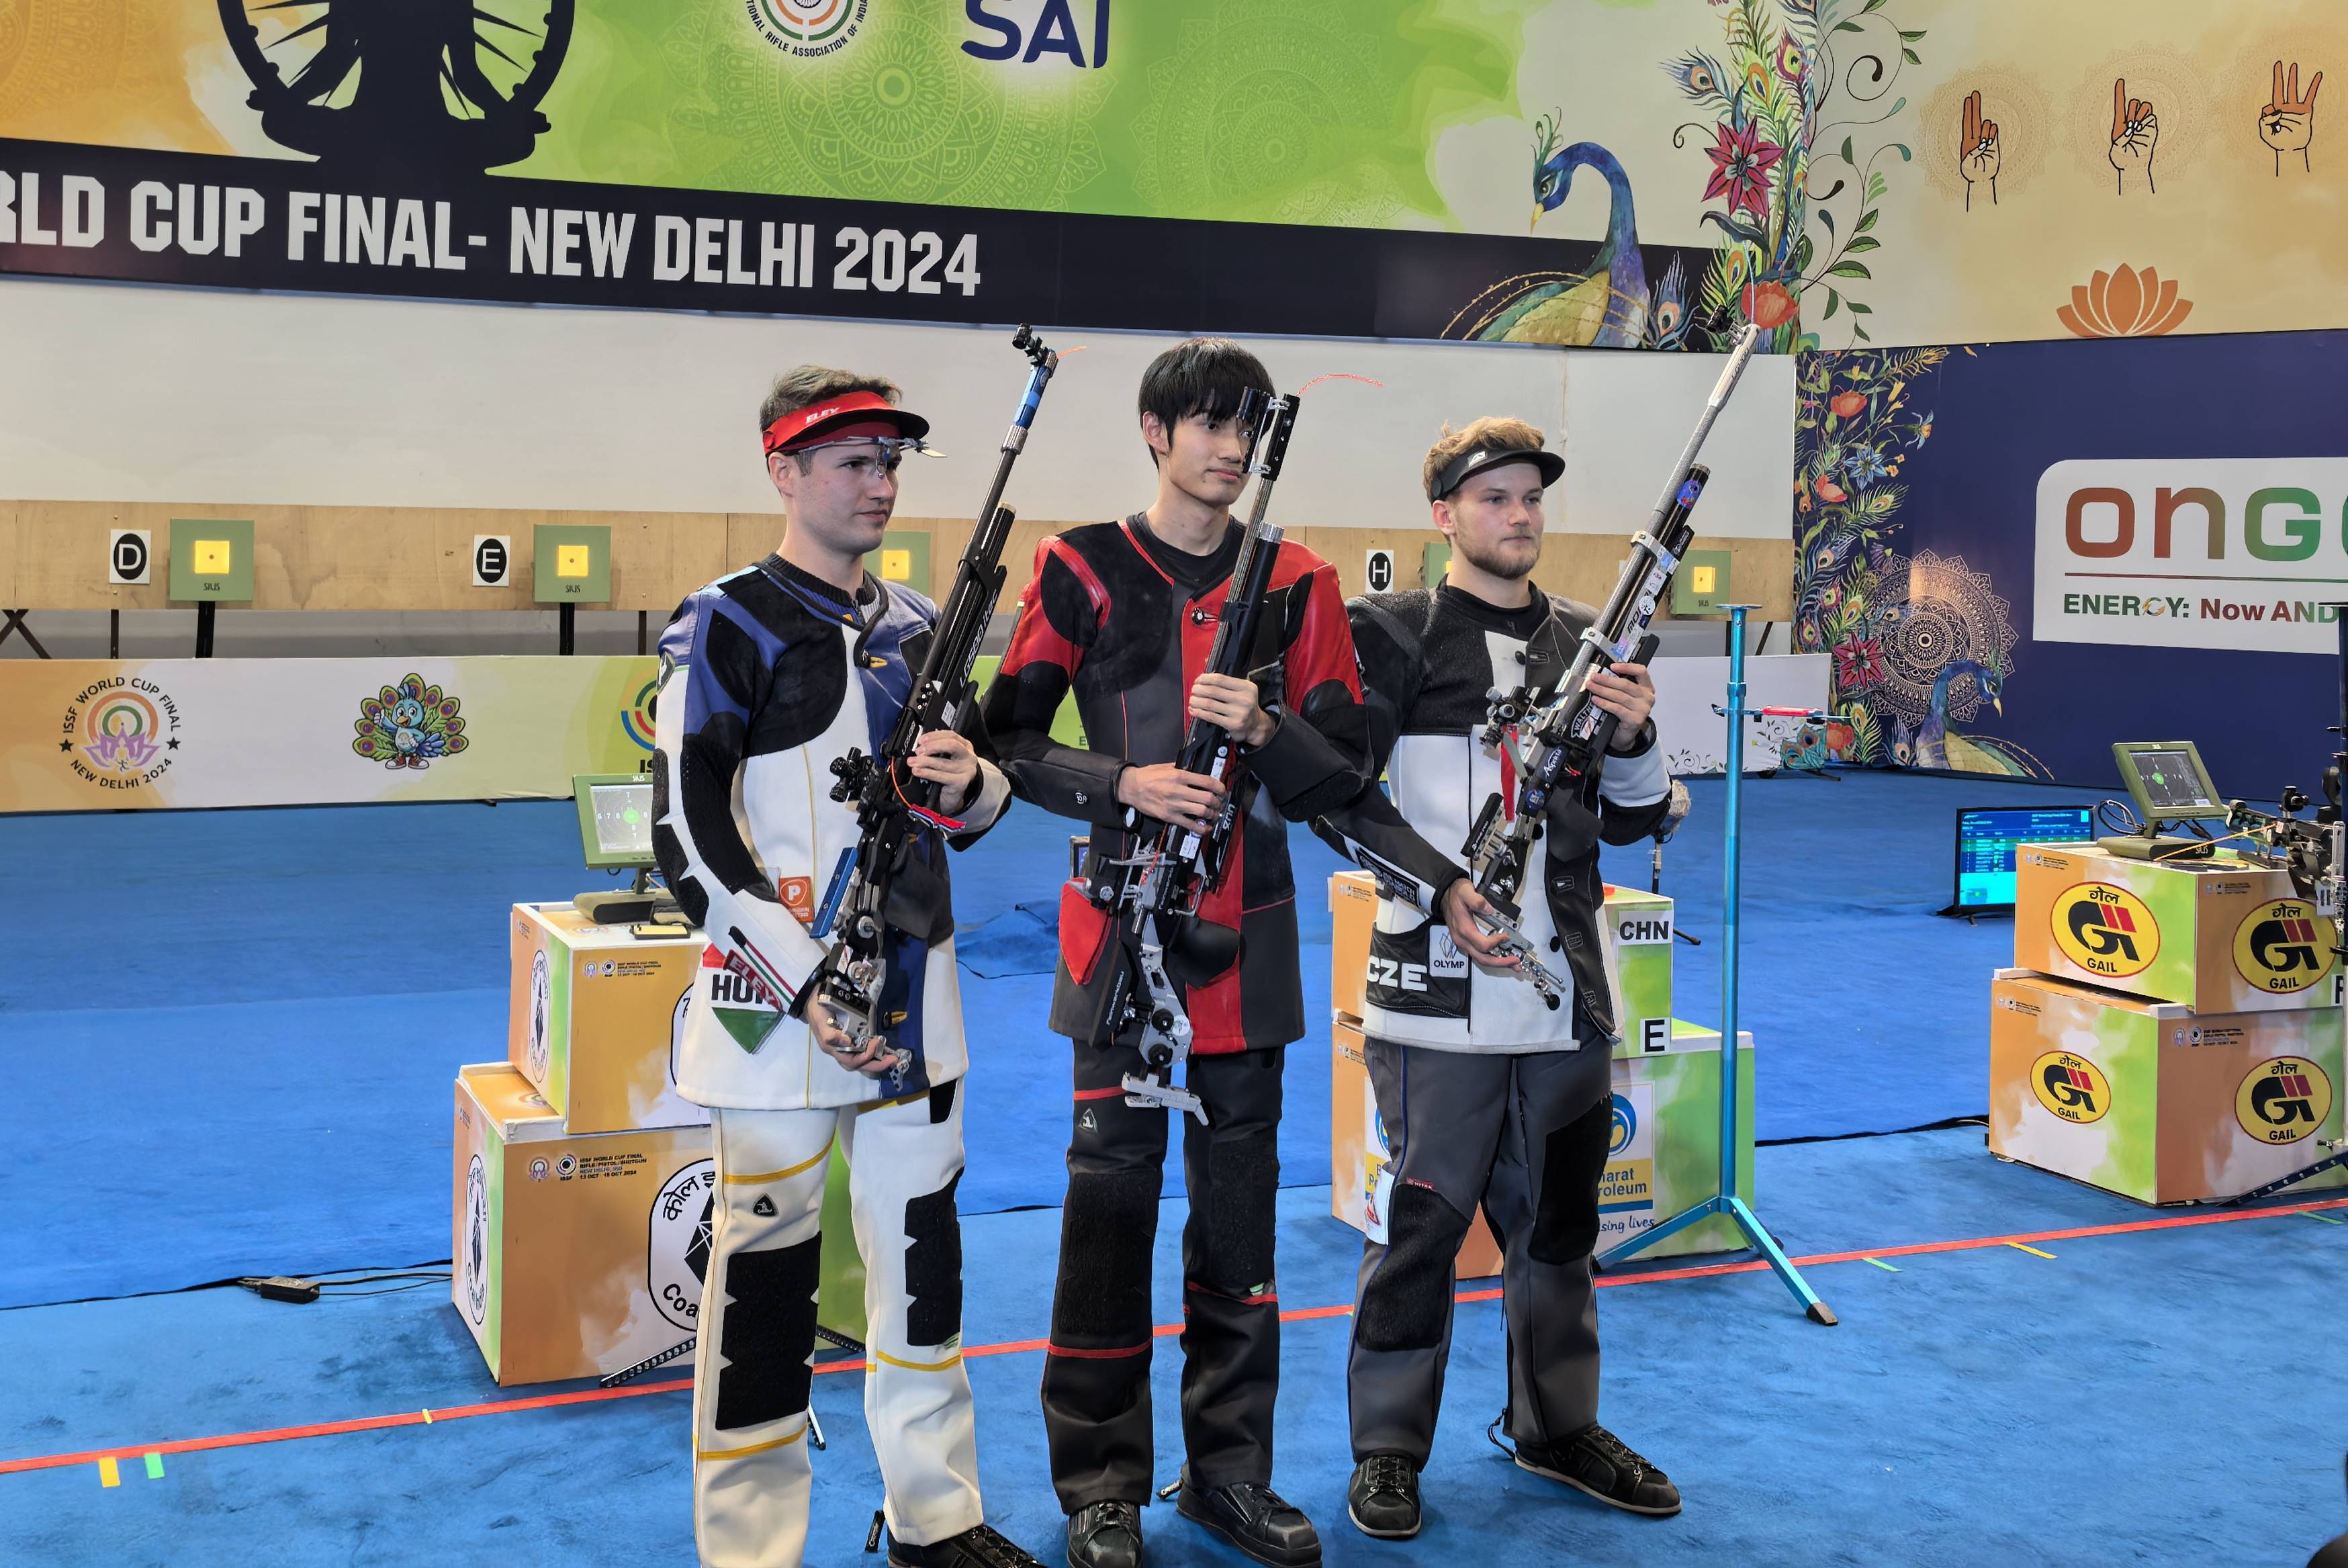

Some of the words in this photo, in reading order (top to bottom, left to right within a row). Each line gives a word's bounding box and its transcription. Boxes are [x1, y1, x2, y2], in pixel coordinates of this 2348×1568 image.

[765, 31, 789, 52] RIFLE
[792, 36, 848, 57] ASSOCIATION
[848, 24, 858, 36] OF
[960, 0, 1110, 68] SAI
[130, 180, 265, 258] CUP
[287, 191, 487, 271] FINAL-
[510, 206, 636, 279] NEW
[653, 215, 815, 287] DELHI
[833, 226, 981, 296] 2024
[118, 543, 142, 569] D
[482, 547, 501, 573] E
[1372, 561, 1388, 583] H
[204, 582, 220, 591] SIUS
[565, 584, 581, 593] SIUS
[63, 706, 78, 733] ISSF
[76, 677, 125, 704] WORLD
[132, 678, 160, 694] CUP
[159, 694, 181, 732] FINAL
[71, 759, 97, 782] NEW
[99, 778, 140, 789] DELHI
[142, 758, 172, 783] 2024
[788, 885, 801, 901] P
[2087, 886, 2120, 905] गेल
[2272, 903, 2302, 919] गेल
[1619, 921, 1670, 941] CHN
[1367, 955, 1427, 992] CZE
[1434, 960, 1465, 969] OLYMP
[2087, 958, 2118, 972] GAIL
[730, 956, 775, 1003] ELEY
[2269, 976, 2300, 990] GAIL
[1644, 1019, 1666, 1053] E
[2059, 1055, 2082, 1070] गेल
[2271, 1060, 2298, 1075] गेल
[2058, 1107, 2081, 1121] GAIL
[2269, 1128, 2296, 1141] GAIL
[1602, 1168, 1634, 1182] arat
[1598, 1183, 1647, 1197] roleum
[1601, 1219, 1625, 1234] sing
[1629, 1215, 1655, 1228] lives
[663, 1283, 699, 1318] Coa
